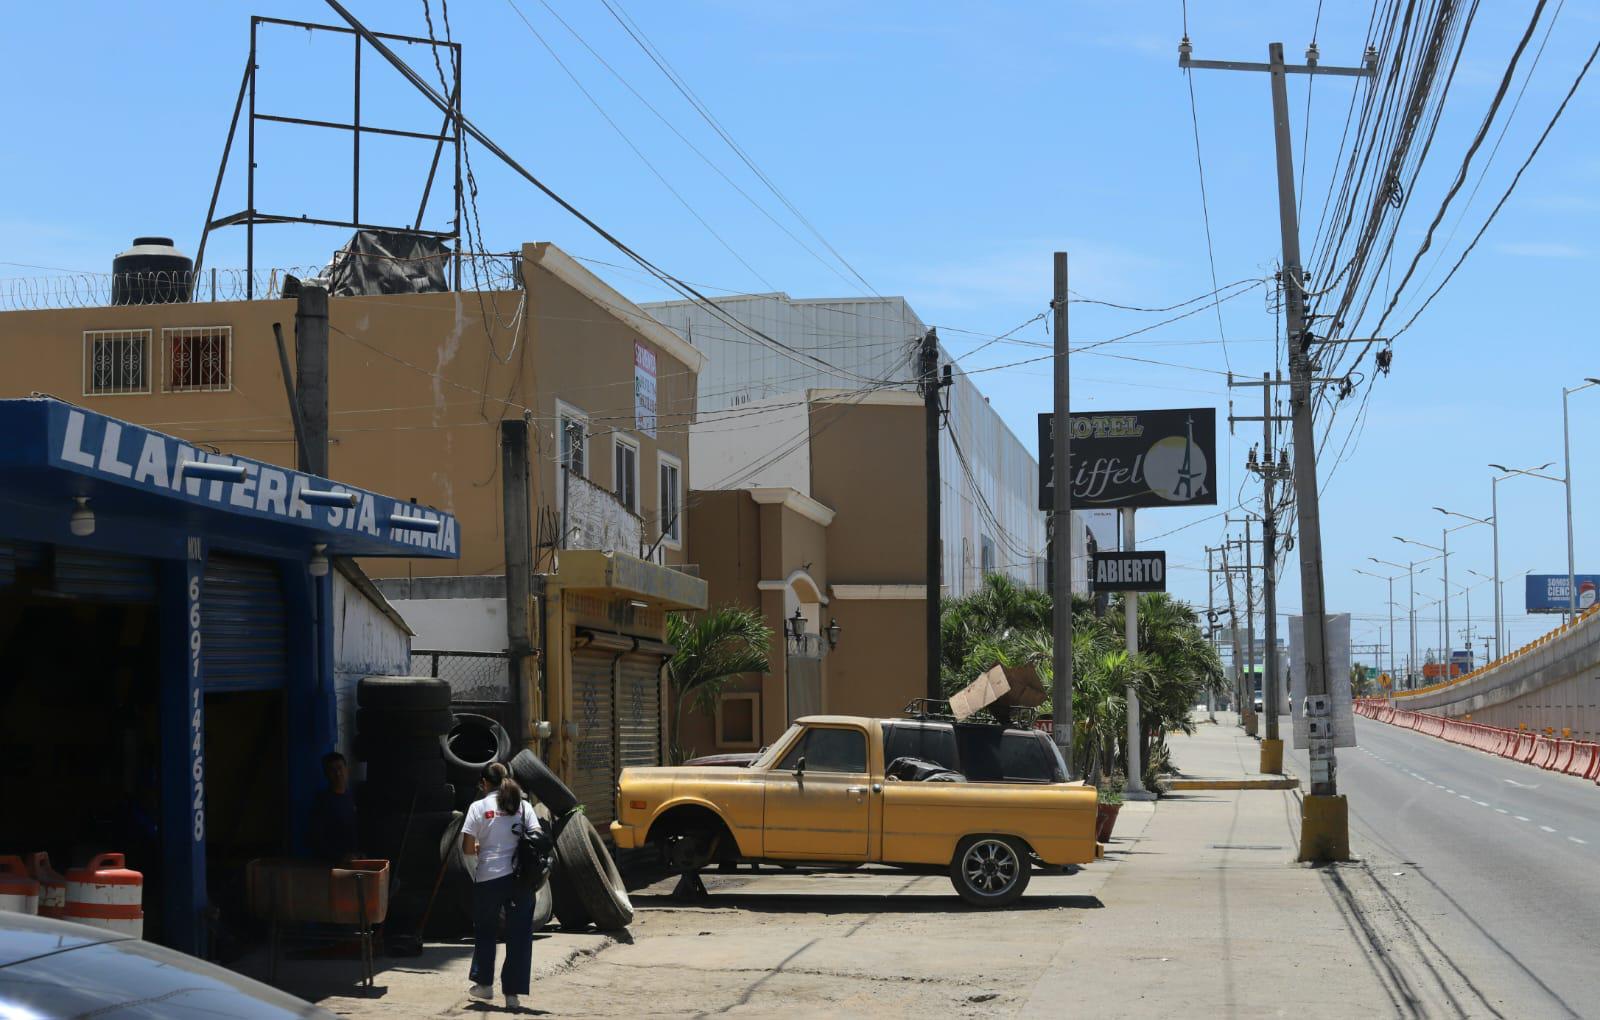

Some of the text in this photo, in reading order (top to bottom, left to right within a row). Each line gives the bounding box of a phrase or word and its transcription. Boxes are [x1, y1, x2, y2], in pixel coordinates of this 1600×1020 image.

[61, 410, 313, 520] LLANTERA
[389, 502, 457, 554] MARIA
[1045, 453, 1143, 498] iffel
[1097, 558, 1162, 583] ABIERTO
[1548, 587, 1577, 596] CIENCA
